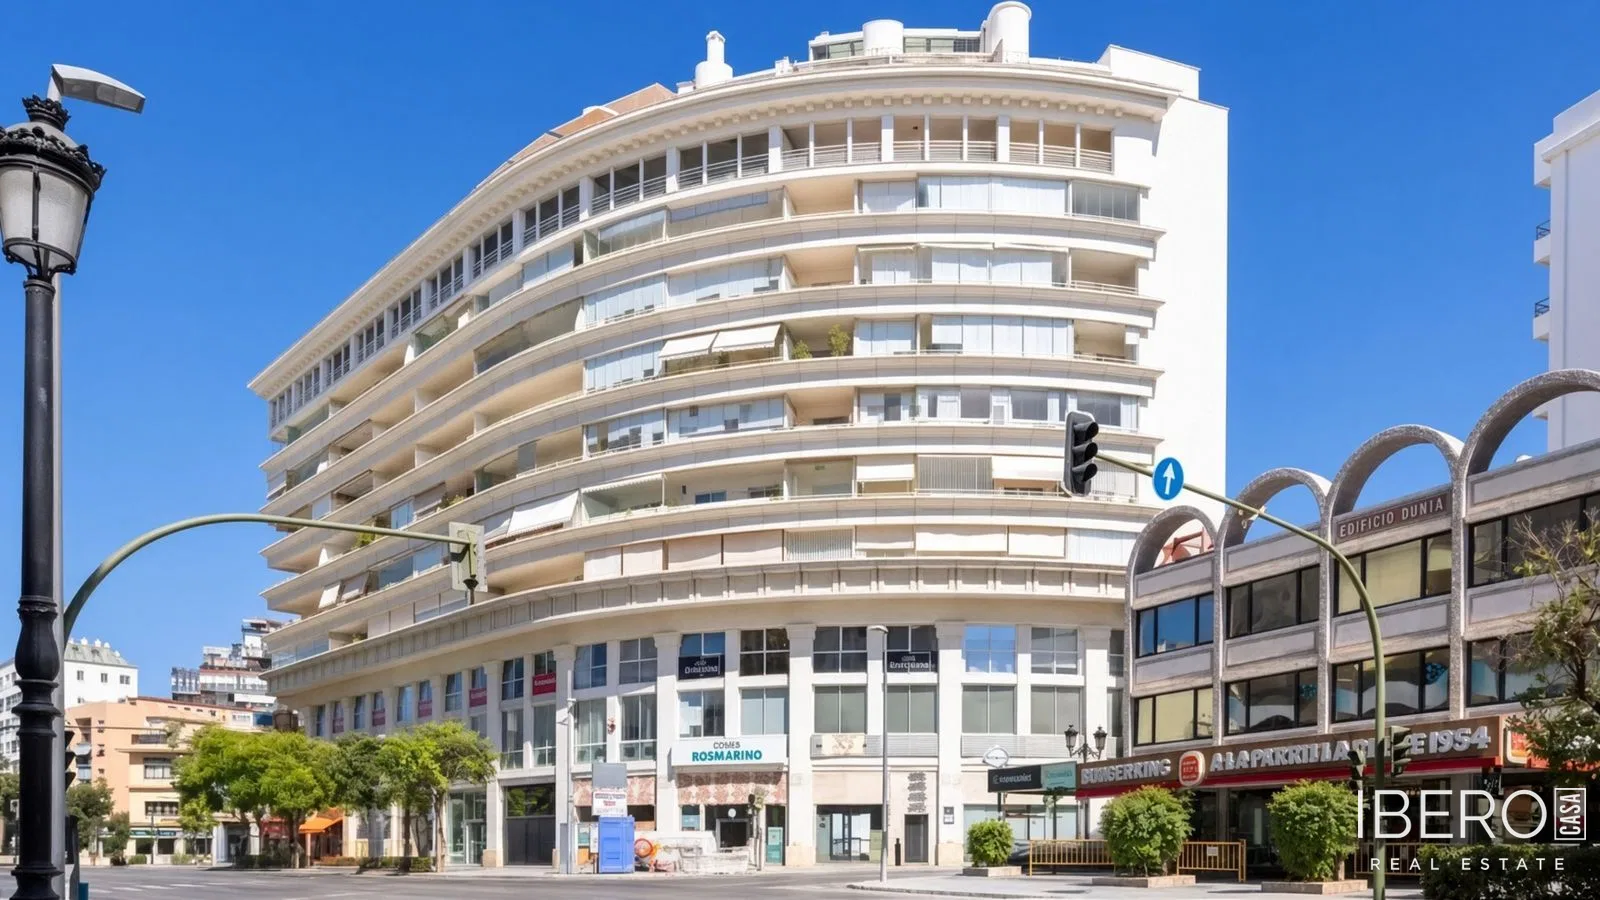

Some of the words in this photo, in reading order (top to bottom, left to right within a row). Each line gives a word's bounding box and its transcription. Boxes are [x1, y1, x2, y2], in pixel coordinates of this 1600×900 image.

[1340, 511, 1394, 537] EDIFICIO
[1402, 497, 1443, 520] DUNIA
[1429, 726, 1491, 753] 1954
[692, 750, 762, 761] ROSMARINO
